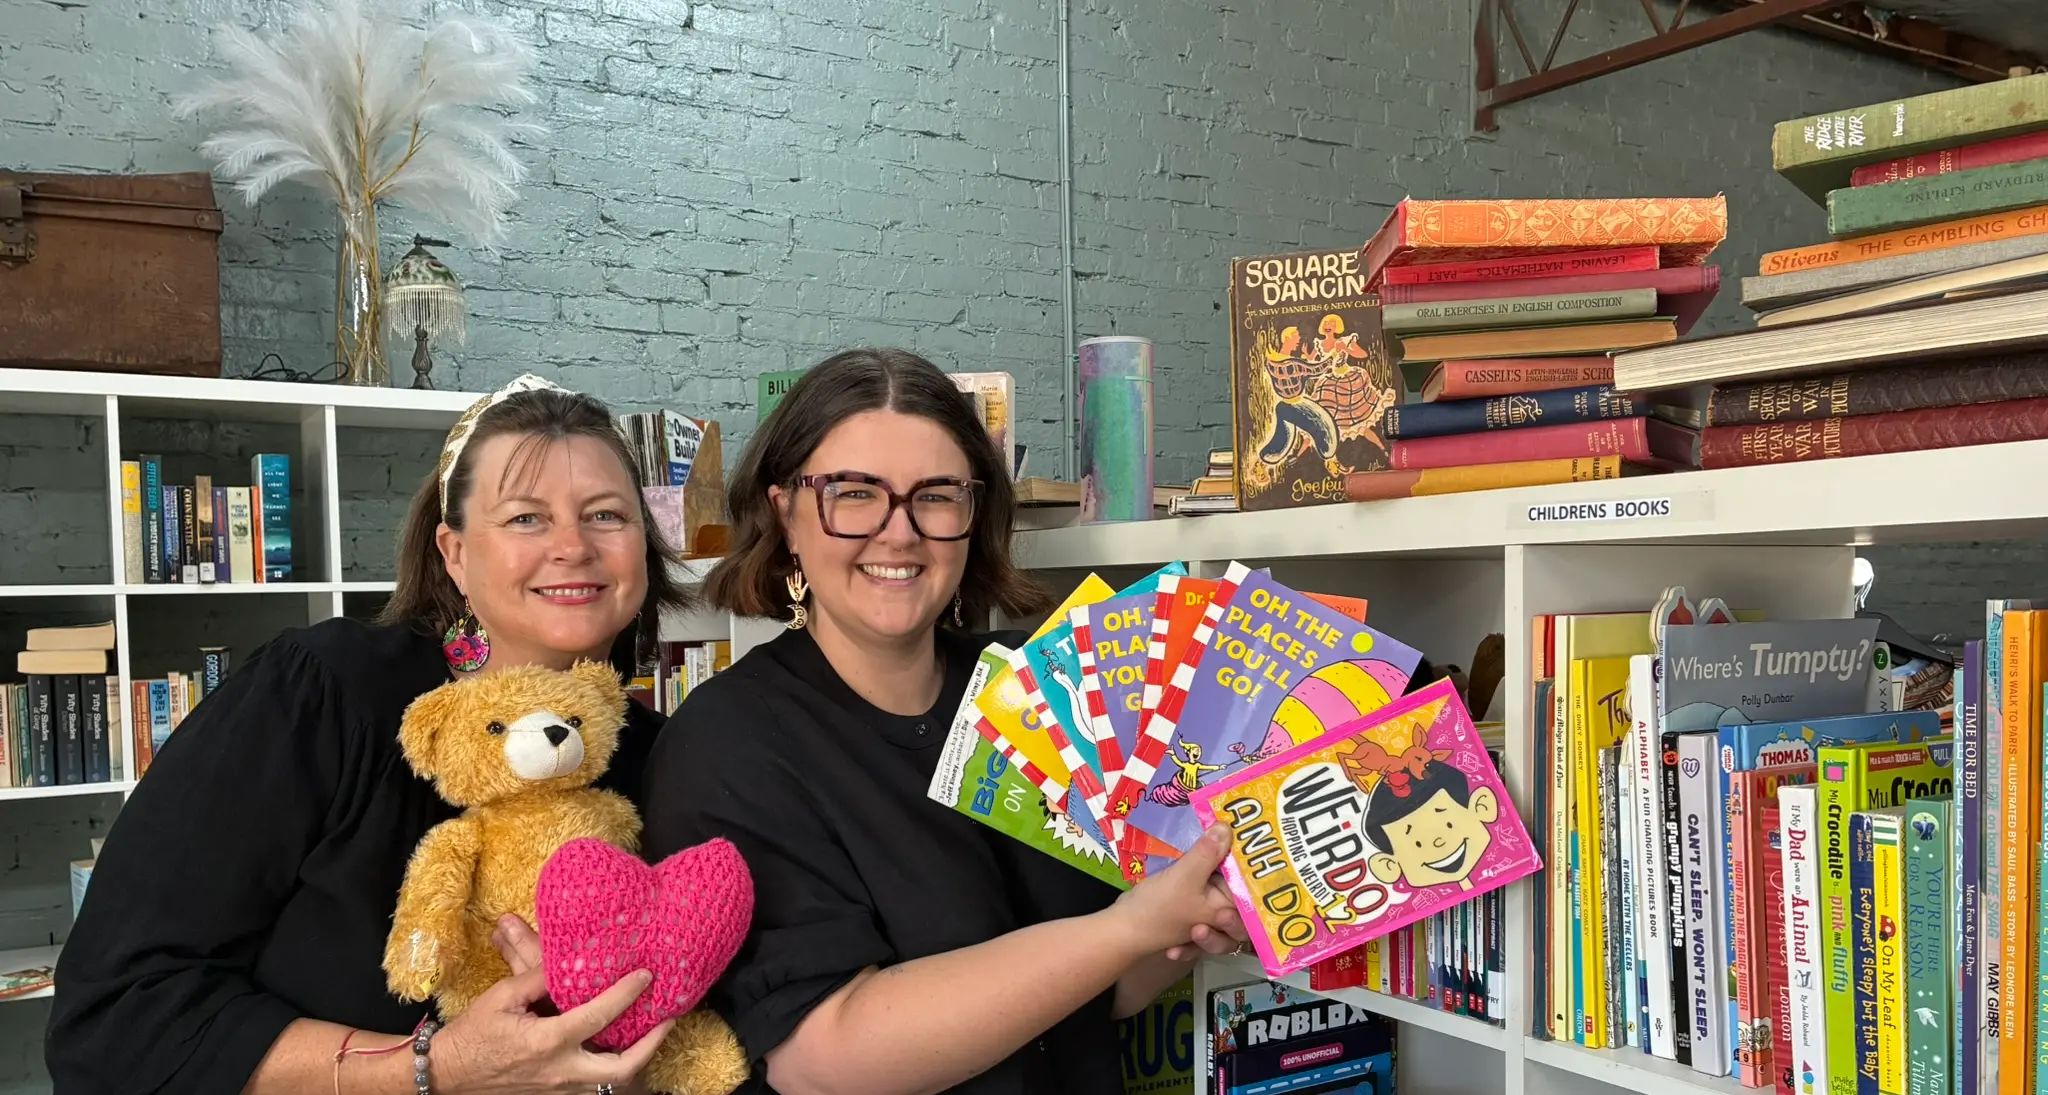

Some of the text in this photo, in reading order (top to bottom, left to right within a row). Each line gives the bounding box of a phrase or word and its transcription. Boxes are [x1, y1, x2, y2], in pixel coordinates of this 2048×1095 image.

[1804, 125, 1815, 144] THE
[1815, 116, 1833, 151] RIDGE
[1834, 131, 1845, 149] AND
[1848, 113, 1867, 147] RIVER
[1904, 172, 2044, 203] RUDYARD KIPLING
[1767, 248, 1839, 273] Stivens
[1858, 239, 1893, 256] THE
[1903, 219, 2005, 248] GAMBLING
[1245, 251, 1361, 287] SQUARE
[1428, 255, 1626, 281] LEAVING MATHEMATICS PART
[1263, 275, 1365, 305] DANCIN
[1416, 296, 1622, 318] ORAL EXERCISES IN ENGLISH COMPOSITION
[1281, 304, 1322, 314] DANCERS
[1330, 302, 1353, 310] NEW
[1465, 369, 1521, 383] CASSELL'S
[674, 418, 700, 442] Owner
[1742, 433, 1753, 456] THE
[1754, 426, 1768, 460] FIRST
[1769, 424, 1784, 460] YEAR
[1785, 433, 1794, 448] OF
[1796, 422, 1812, 457] WAR
[1812, 432, 1821, 444] IN
[1824, 417, 1841, 456] PICTURES
[183, 488, 193, 544] COLIN DEXTER
[1528, 499, 1670, 523] CHILDRENS BOOKS
[1185, 592, 1205, 605] Dr.
[1103, 608, 1146, 632] OH,
[1250, 589, 1344, 649] OH, THE
[1225, 605, 1319, 669] PLACES
[206, 654, 218, 687] GORDON
[1214, 631, 1292, 690] YOU'LL
[1671, 639, 1870, 683] Where's Tumpty?
[67, 693, 76, 711] Fifty
[1216, 667, 1263, 703] GO!
[1741, 694, 1794, 708] Polly Dunbar
[39, 694, 49, 741] Fifty Shades
[92, 694, 101, 739] Fifty Shades
[1638, 721, 1649, 782] ALPHABET
[1761, 748, 1809, 766] THOMAS
[1004, 783, 1027, 812] ON
[1642, 787, 1650, 795] A
[1667, 787, 1675, 809] touch
[1791, 814, 1800, 827] My
[2006, 636, 2018, 1039] HENRI'S WALK TO PARIS ILLUSTRATED BY SAUL BASS STORY BY LEONORE KLEIN
[1281, 816, 1306, 863] HOPPING
[1667, 822, 1682, 871] grumpy
[1788, 827, 1806, 861] Dad
[1965, 703, 1977, 976] TIME FOR BED Mem Fox & Jane Dyer
[1223, 797, 1316, 947] ANH DO
[1622, 859, 1630, 870] AT
[1300, 862, 1357, 934] WEIRD! 12
[1623, 871, 1631, 895] HOME
[1646, 868, 1656, 910] PICTURES
[1795, 885, 1802, 895] an
[1826, 789, 1848, 993] My Crocodile pink AND fluffy
[1624, 920, 1632, 934] THE
[1649, 914, 1658, 938] BOOK
[1669, 876, 1684, 946] pumpkins
[1688, 813, 1708, 1041] CAN'T SLEEP. WON'T SLEEP.
[1909, 856, 1925, 979] FOR A REASON
[1925, 864, 1943, 973] YOU'RE HERE
[1735, 860, 1748, 1011] NODDY AND THE MAGIC RUBBER
[1792, 894, 1810, 964] Animal
[1625, 937, 1633, 971] HEELERS
[1856, 957, 1878, 997] sleepy
[1880, 945, 1898, 1030] On My Leaf
[1862, 1000, 1878, 1022] but
[1987, 962, 2000, 1038] MAY GIBBS
[1248, 1003, 1369, 1046] ROBLOX
[1862, 1024, 1879, 1047] the
[1283, 1047, 1340, 1066] 100% UNOFFICIAL
[1859, 1051, 1879, 1081] Baby
